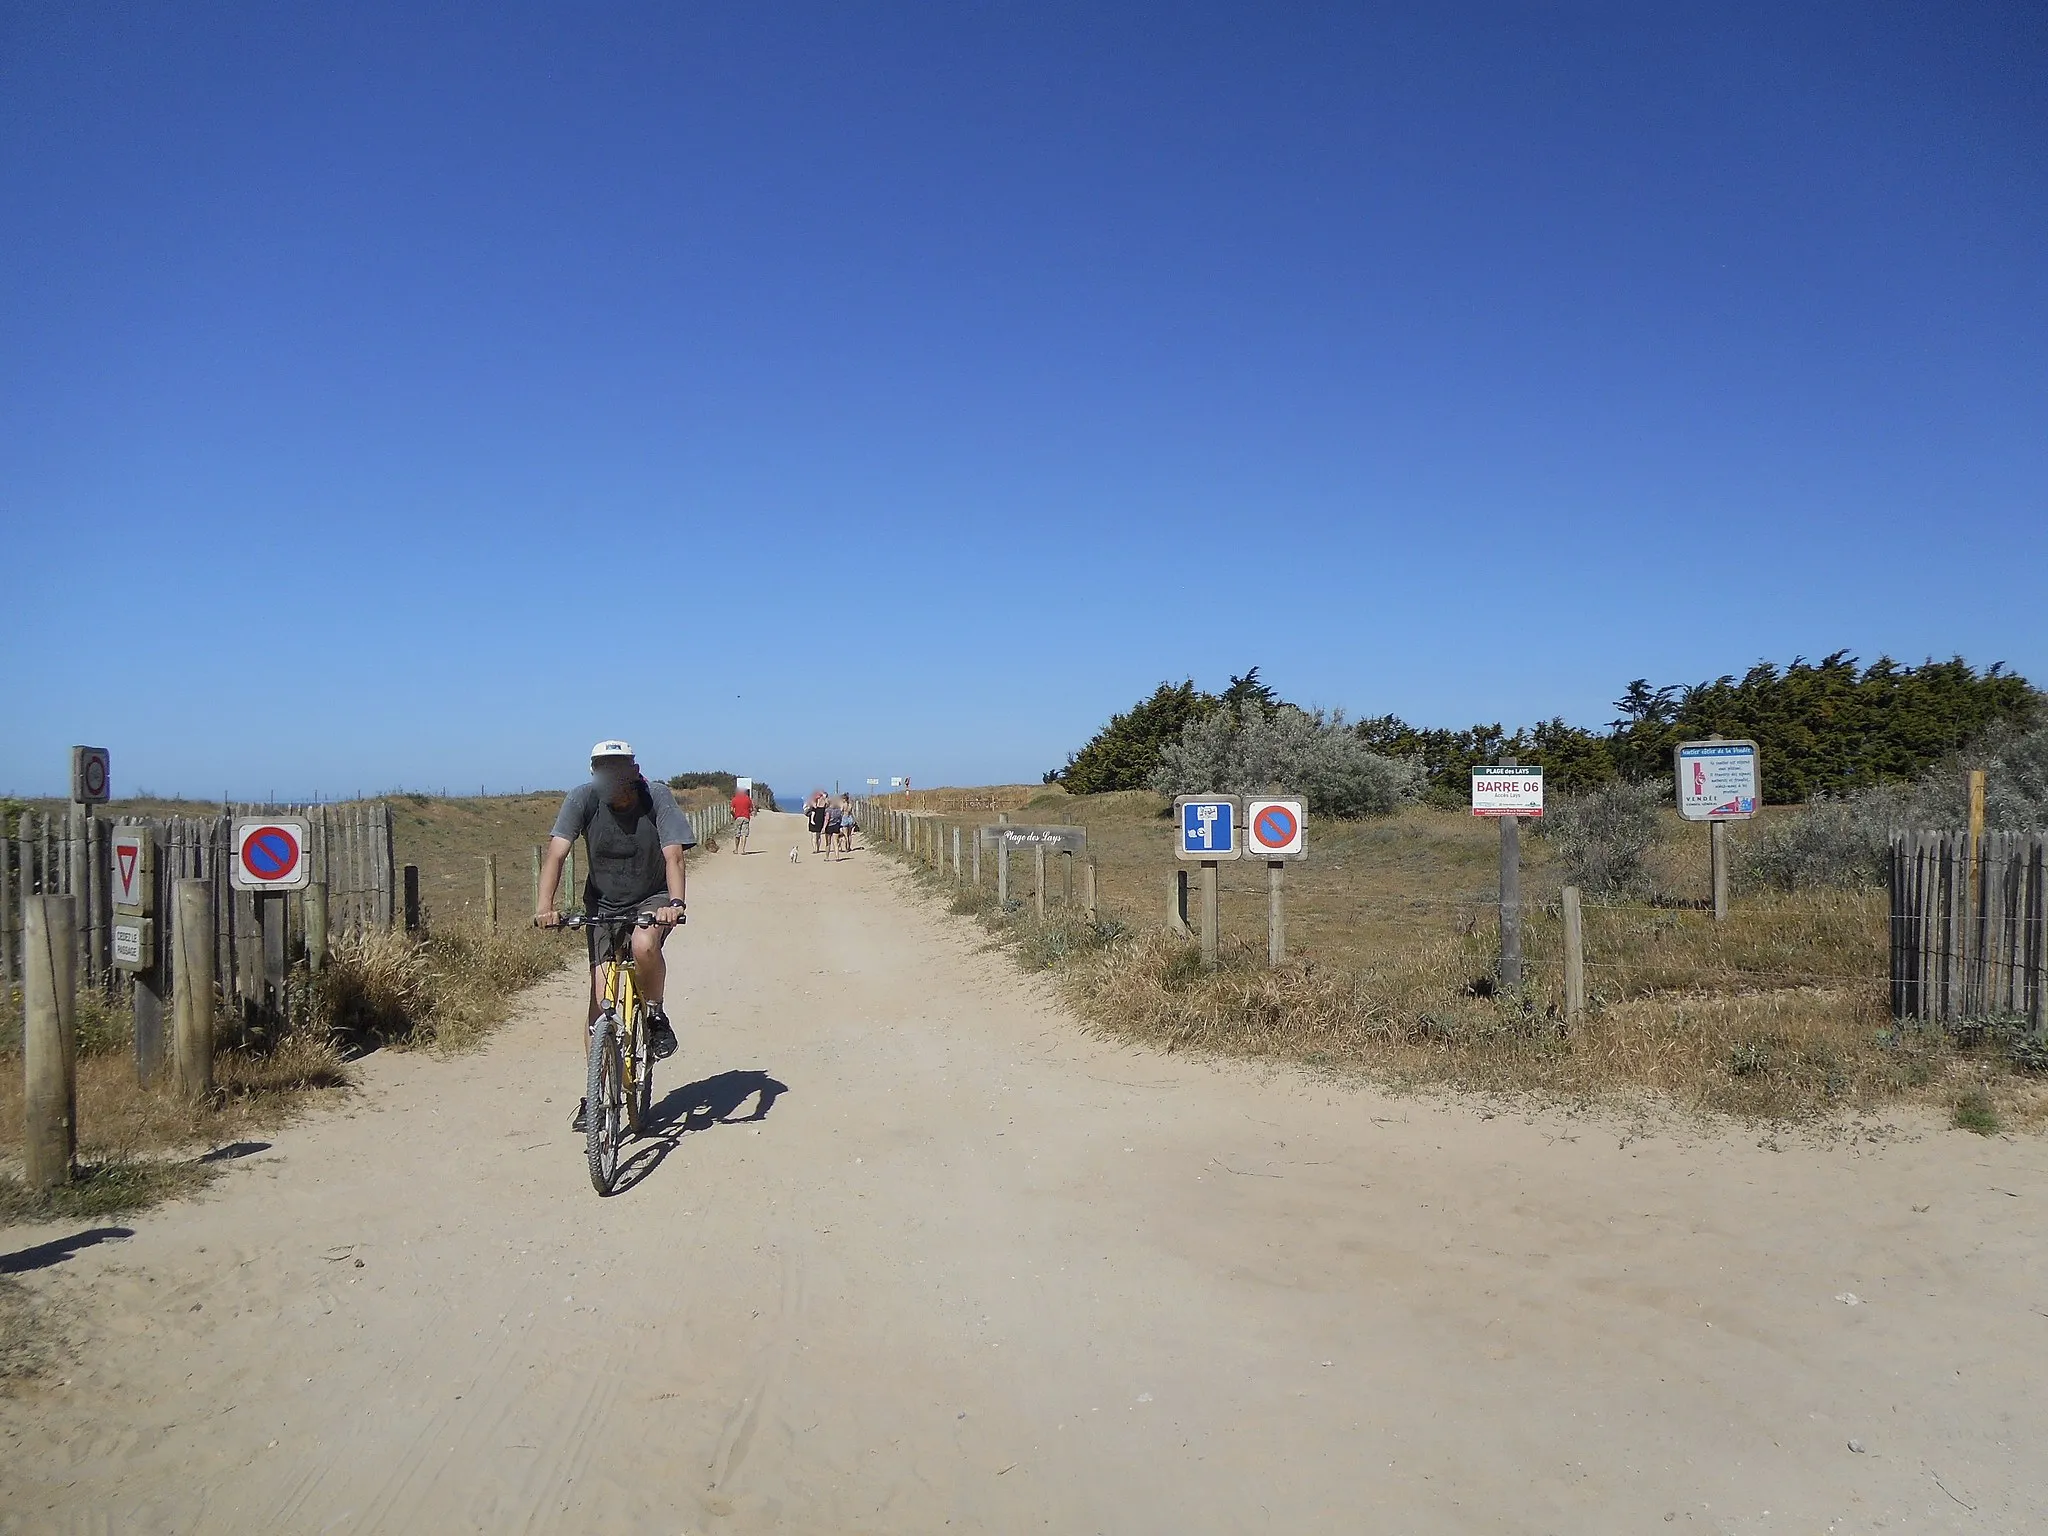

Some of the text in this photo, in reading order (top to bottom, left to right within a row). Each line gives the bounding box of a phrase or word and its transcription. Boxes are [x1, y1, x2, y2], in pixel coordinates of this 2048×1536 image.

[1477, 781, 1539, 792] BARRE 06
[1003, 830, 1062, 845] Plage des Lays
[131, 933, 138, 943] LE
[117, 944, 137, 957] PASSAGE
